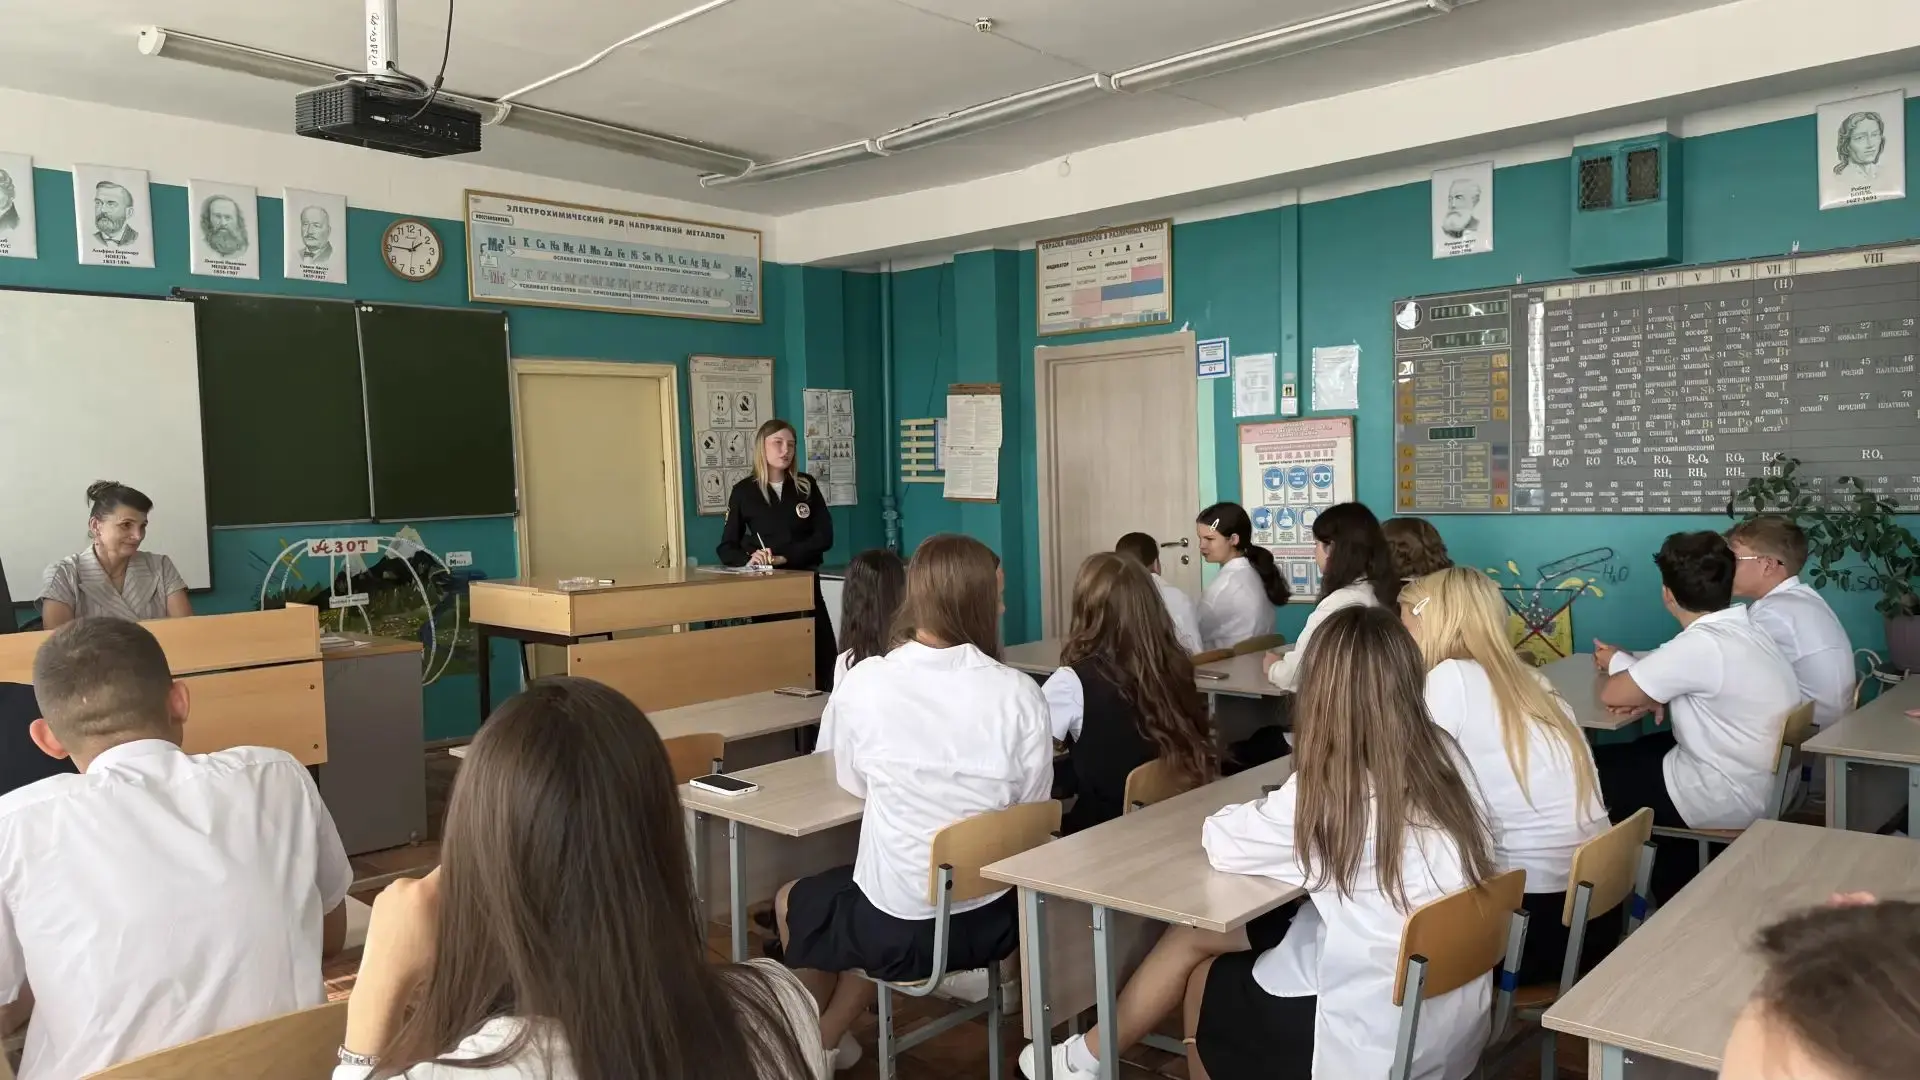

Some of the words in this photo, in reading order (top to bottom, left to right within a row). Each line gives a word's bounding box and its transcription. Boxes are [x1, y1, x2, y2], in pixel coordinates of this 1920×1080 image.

[506, 204, 604, 224] ЭЛЕКТРОХИМИЧЕСКИЙ
[608, 218, 624, 227] РЯД
[629, 221, 682, 233] НАПРЯЖЕНИЙ
[686, 229, 725, 240] МЕТАЛЛОВ
[508, 236, 516, 245] Li
[523, 238, 529, 248] K
[536, 239, 546, 250] Ca
[550, 241, 560, 251] Na
[564, 242, 574, 253] Mg
[579, 244, 586, 254] Al
[590, 246, 600, 256] Mn
[604, 247, 612, 256] Zn
[618, 249, 625, 258] Fe
[690, 258, 699, 268] Ag
[1621, 280, 1631, 290] III
[1657, 277, 1666, 286] IV
[1694, 273, 1702, 282] V
[1730, 269, 1740, 278] VI
[1766, 264, 1781, 274] VII
[1864, 253, 1884, 264] VIII
[1774, 278, 1793, 291] (H)
[1777, 347, 1791, 356] Br
[1586, 458, 1600, 466] RO
[312, 539, 368, 553] АЗОТ
